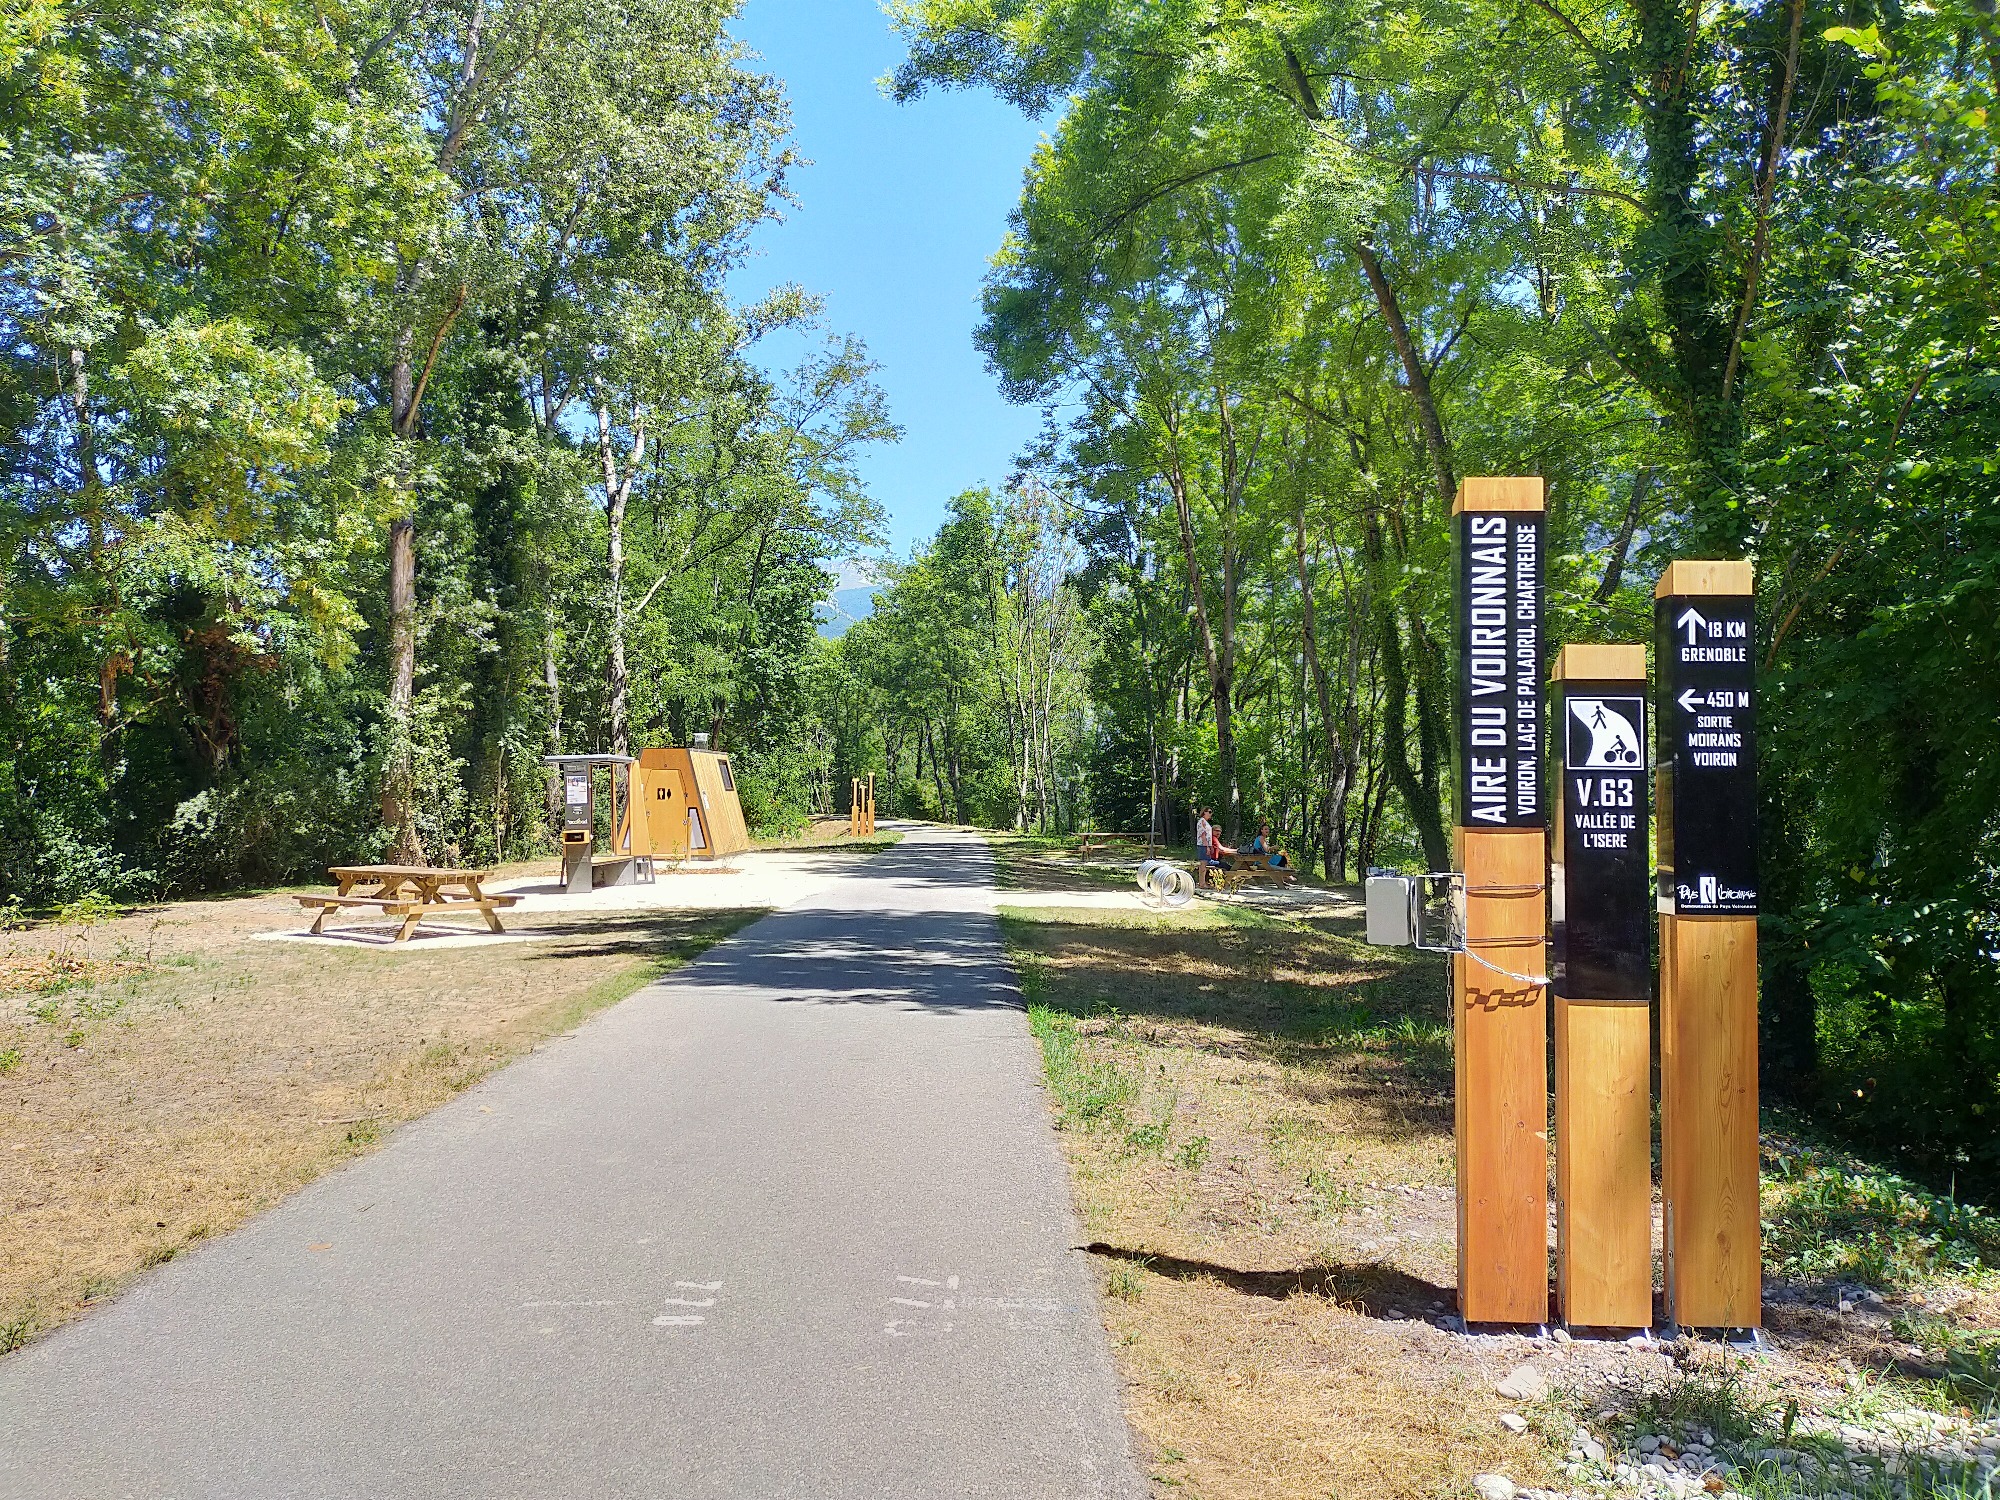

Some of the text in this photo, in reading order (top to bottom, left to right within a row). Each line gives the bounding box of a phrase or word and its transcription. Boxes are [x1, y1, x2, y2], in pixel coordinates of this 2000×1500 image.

[1708, 622, 1746, 637] 18 KM
[1682, 648, 1746, 661] GRENOBLE
[1471, 518, 1506, 823] AIRE DU VOIRONNAIS
[1517, 525, 1537, 815] VOIRON, LAC DE PALADRU, CHARTREUSE
[1707, 692, 1748, 707] 450 M
[1698, 716, 1732, 728] SORTIE
[1689, 733, 1741, 747] MOIRANS
[1694, 753, 1736, 766] VOIRON
[1577, 779, 1632, 806] V.63
[1575, 812, 1635, 828] VALLÉE DE
